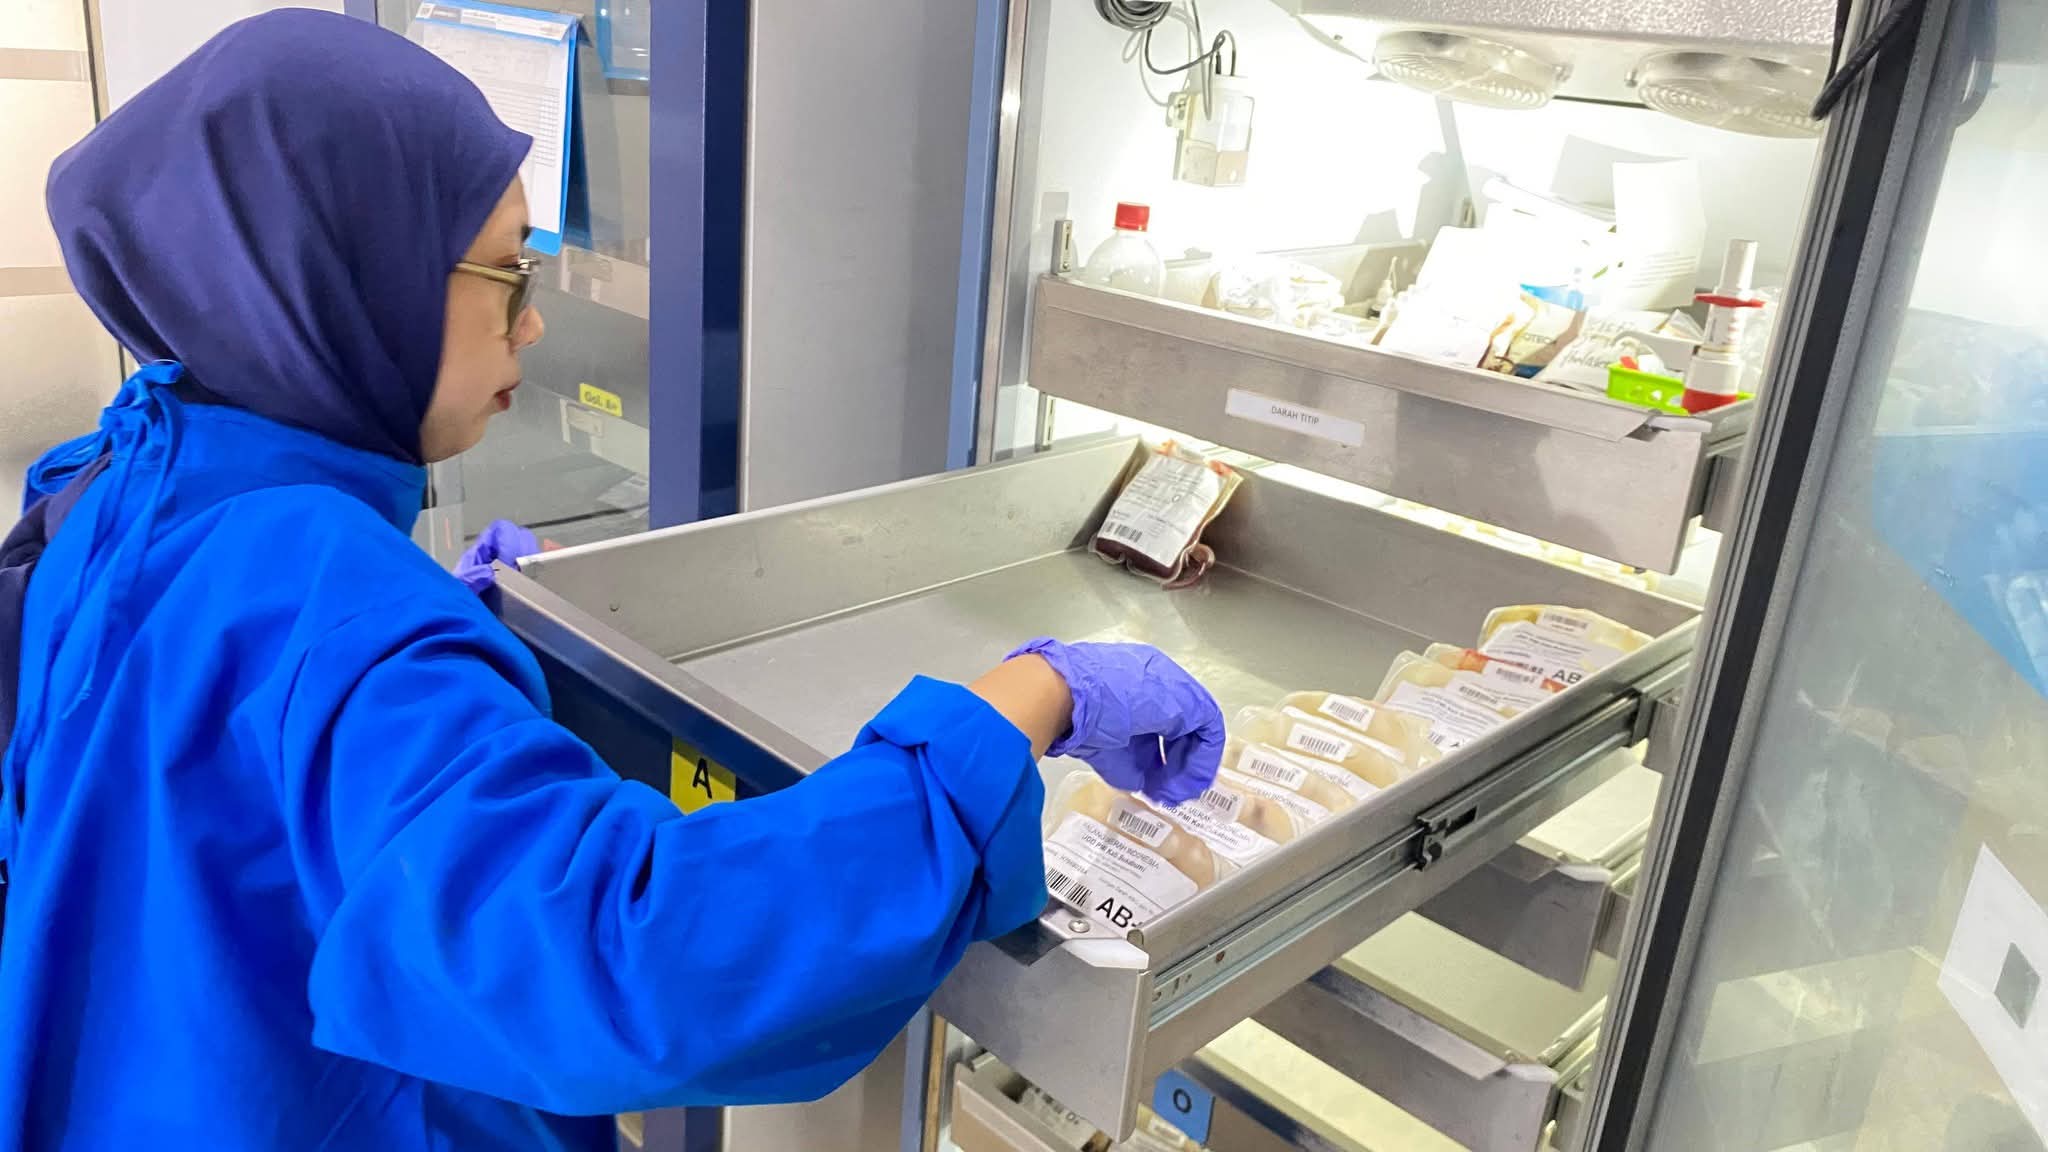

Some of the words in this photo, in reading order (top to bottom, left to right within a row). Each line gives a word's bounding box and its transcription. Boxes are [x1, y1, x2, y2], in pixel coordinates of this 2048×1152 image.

[1271, 405, 1298, 420] DARAH
[1300, 412, 1320, 425] TITIP
[692, 757, 713, 799] A
[1173, 1087, 1192, 1114] O
